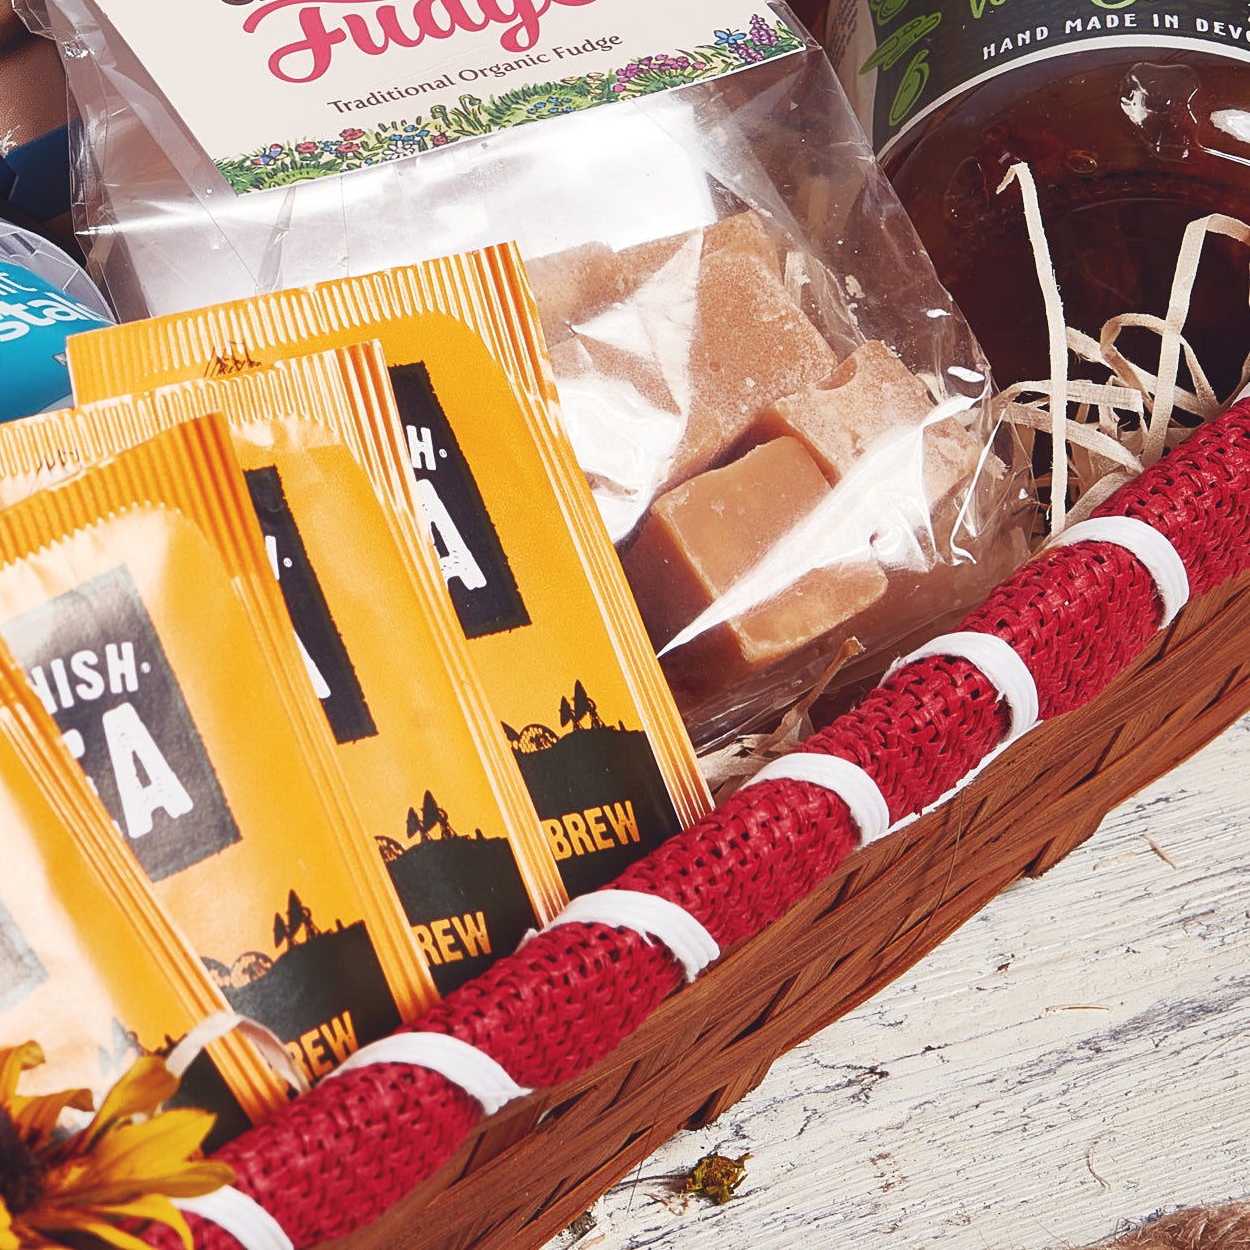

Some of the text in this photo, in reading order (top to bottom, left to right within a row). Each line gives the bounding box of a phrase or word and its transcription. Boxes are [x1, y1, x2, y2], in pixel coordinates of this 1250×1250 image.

[982, 13, 1250, 60] HAND MADE IN DEV
[327, 33, 623, 114] Traditional Organic Fudge
[540, 800, 641, 861] BREW
[410, 910, 492, 967] REW
[285, 1010, 359, 1081] REW
